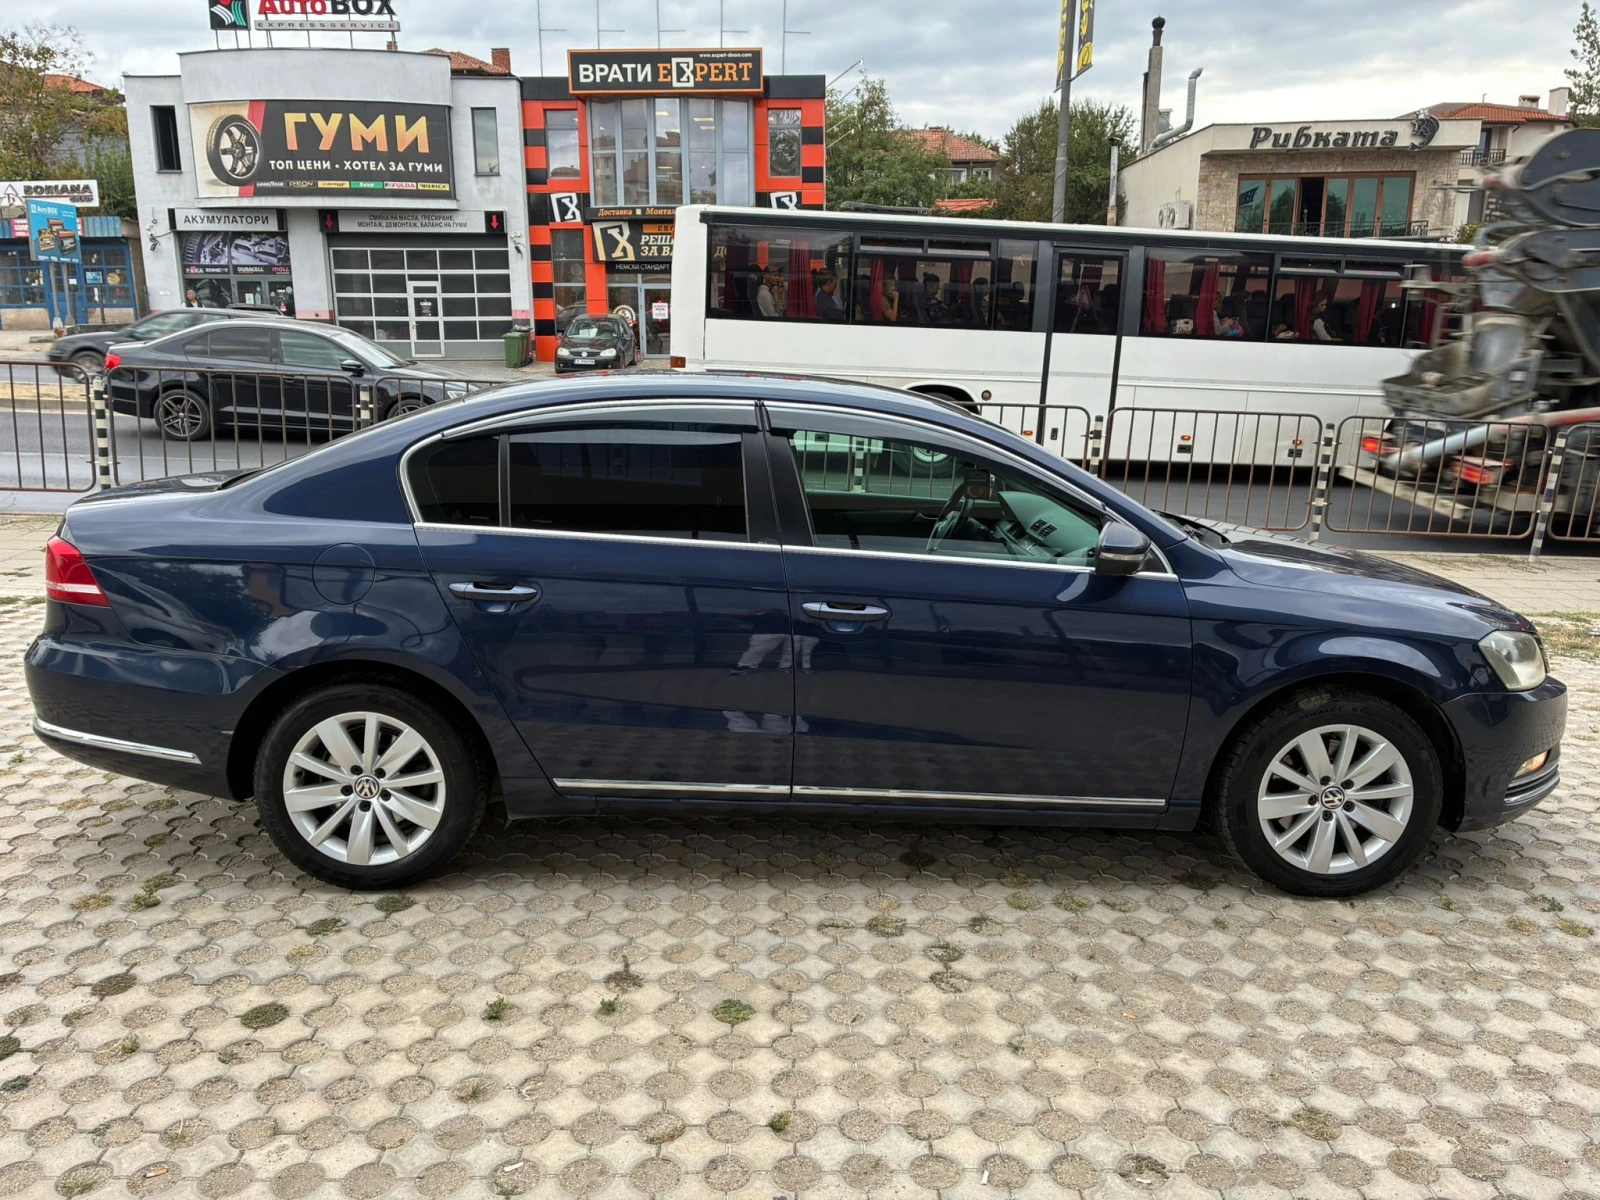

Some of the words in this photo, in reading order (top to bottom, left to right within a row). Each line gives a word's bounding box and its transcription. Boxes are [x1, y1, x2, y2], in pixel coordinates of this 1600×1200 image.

[578, 63, 652, 83] ВРАТИ
[657, 58, 753, 87] EXPERT
[284, 113, 430, 153] ГУМИ
[1249, 125, 1398, 149] Рибката
[269, 160, 293, 170] ТОП
[297, 160, 331, 171] ЦЕНИ
[344, 161, 385, 171] ХОТЕЛ
[389, 162, 405, 172] ЗА
[409, 163, 443, 172] ГУМИ
[23, 184, 93, 195] BORIANA
[598, 208, 632, 216] Доставка
[183, 215, 269, 225] АКУМУЛАТОРИ
[640, 235, 674, 245] РЕШ
[640, 246, 658, 256] ЗА
[661, 246, 673, 256] В
